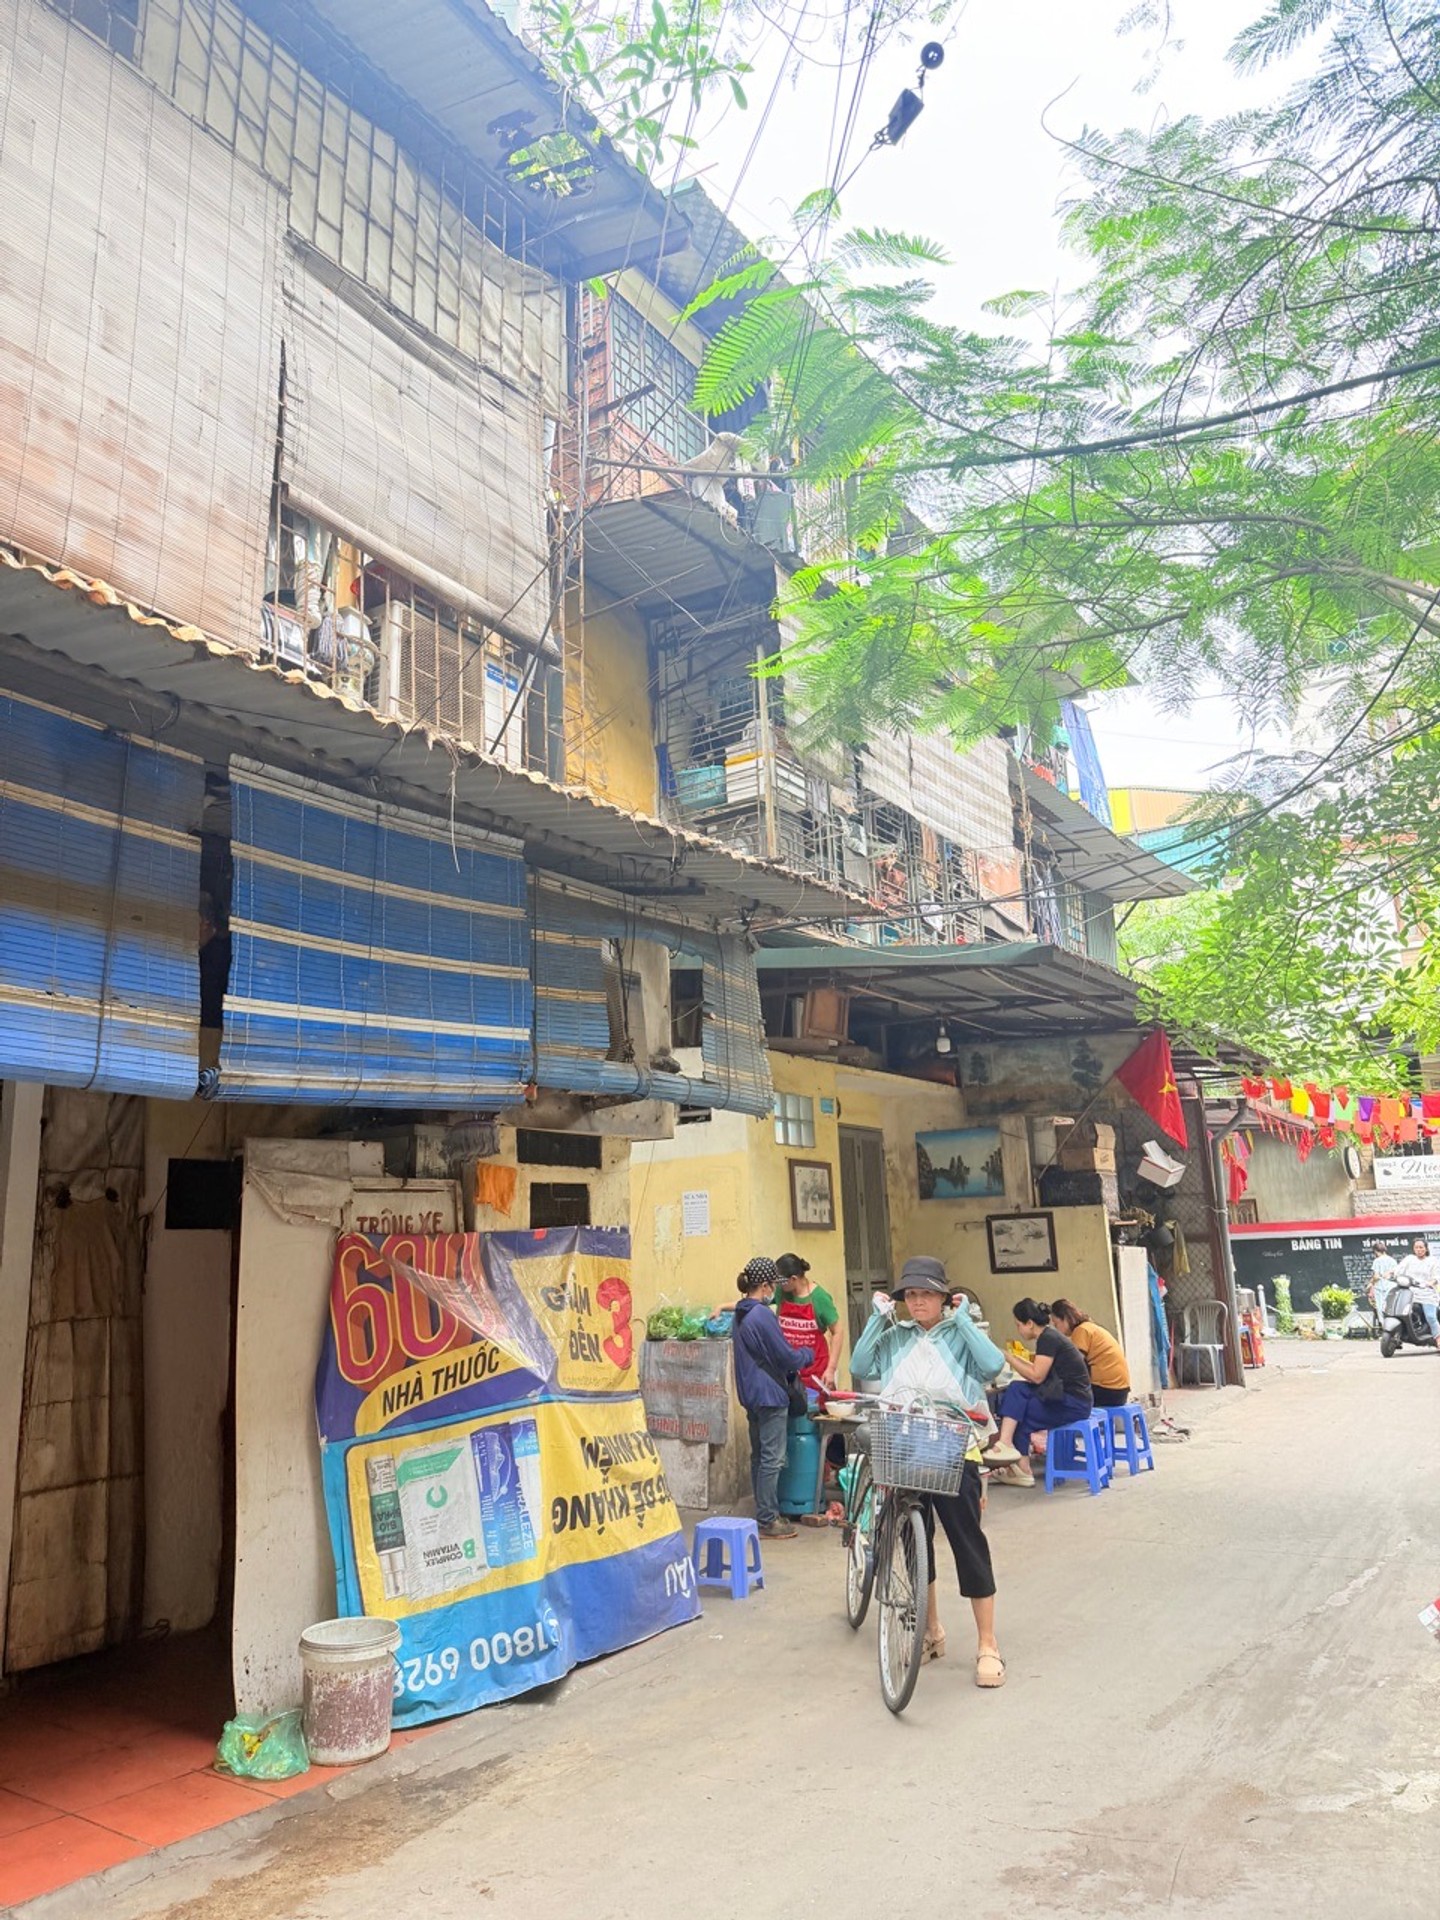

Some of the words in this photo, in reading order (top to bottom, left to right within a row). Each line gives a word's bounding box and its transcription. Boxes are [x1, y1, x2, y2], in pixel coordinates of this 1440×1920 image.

[356, 1208, 414, 1234] TRÔNG
[418, 1211, 444, 1234] XE
[1291, 1237, 1322, 1251] BẢNG
[1323, 1238, 1343, 1250] TIN
[780, 1319, 816, 1329] Yakult
[569, 1316, 603, 1363] ĐẾN
[382, 1370, 425, 1417] NHÀ
[432, 1340, 500, 1395] THUỐC
[580, 1433, 638, 1485] NHIỄM
[552, 1484, 631, 1536] KHÁNG
[423, 1543, 461, 1560] VITAMIN
[425, 1552, 464, 1568] COMPLEX
[462, 1538, 476, 1560] B
[469, 1621, 549, 1671] 1800
